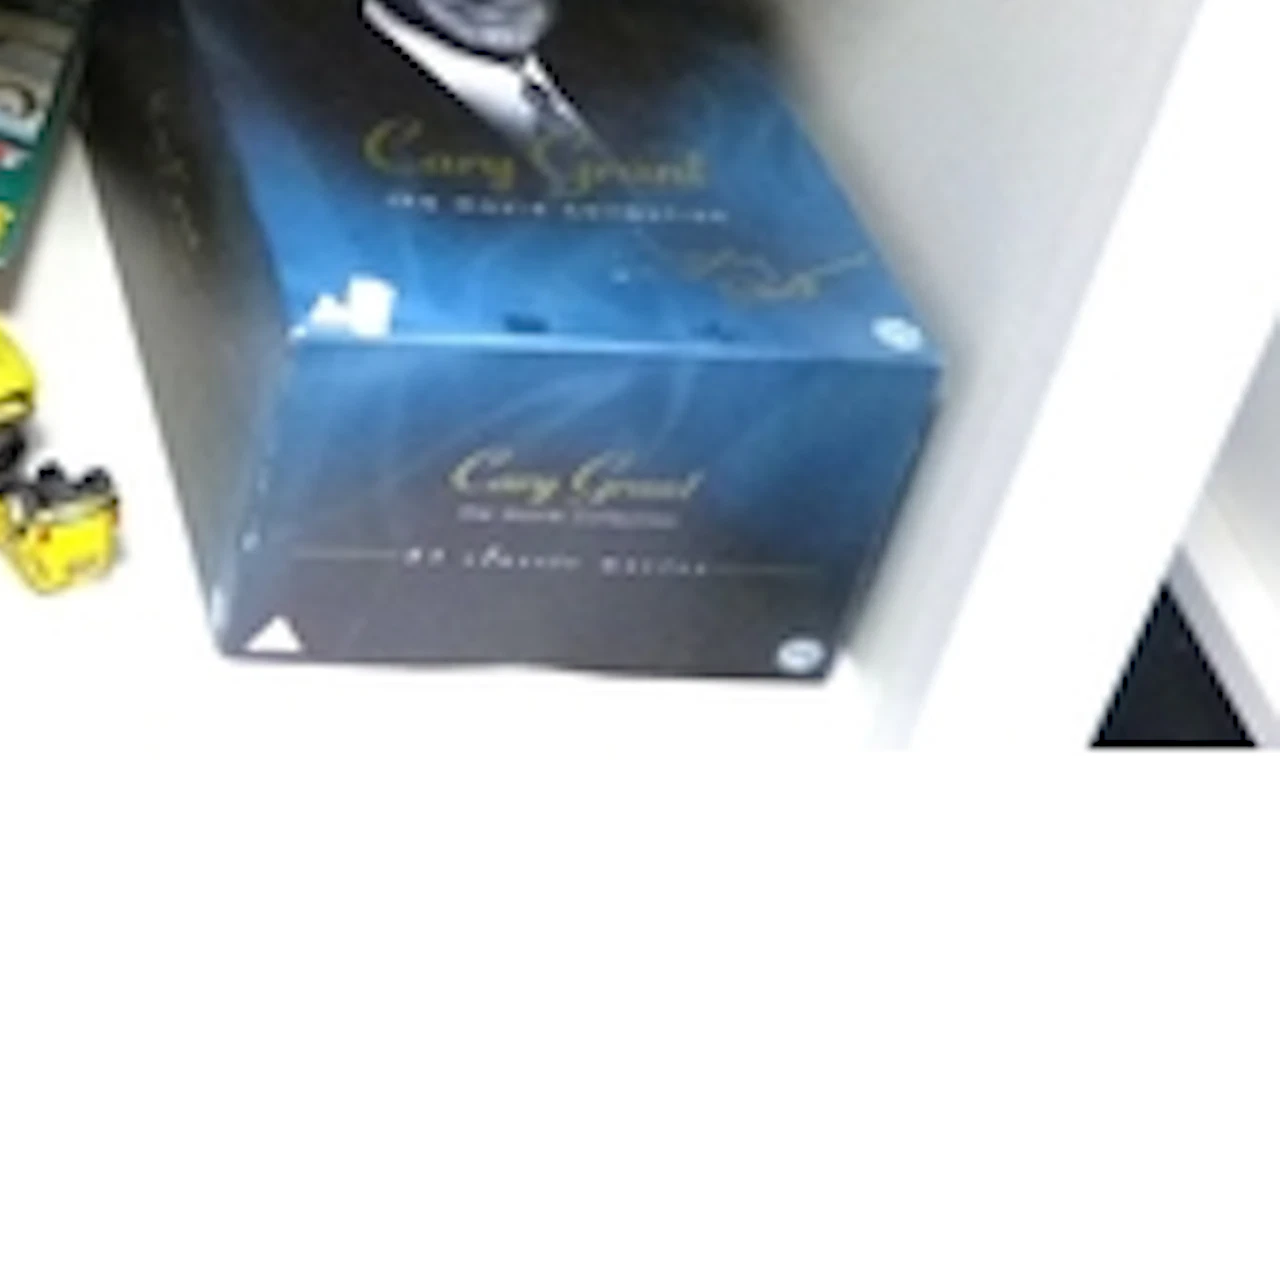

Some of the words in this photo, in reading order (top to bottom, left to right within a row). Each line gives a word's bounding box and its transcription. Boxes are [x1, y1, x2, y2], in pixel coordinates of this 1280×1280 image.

[362, 117, 517, 190] Cary
[528, 128, 709, 199] Grant
[449, 447, 561, 505] Cary
[571, 449, 706, 505] Grant
